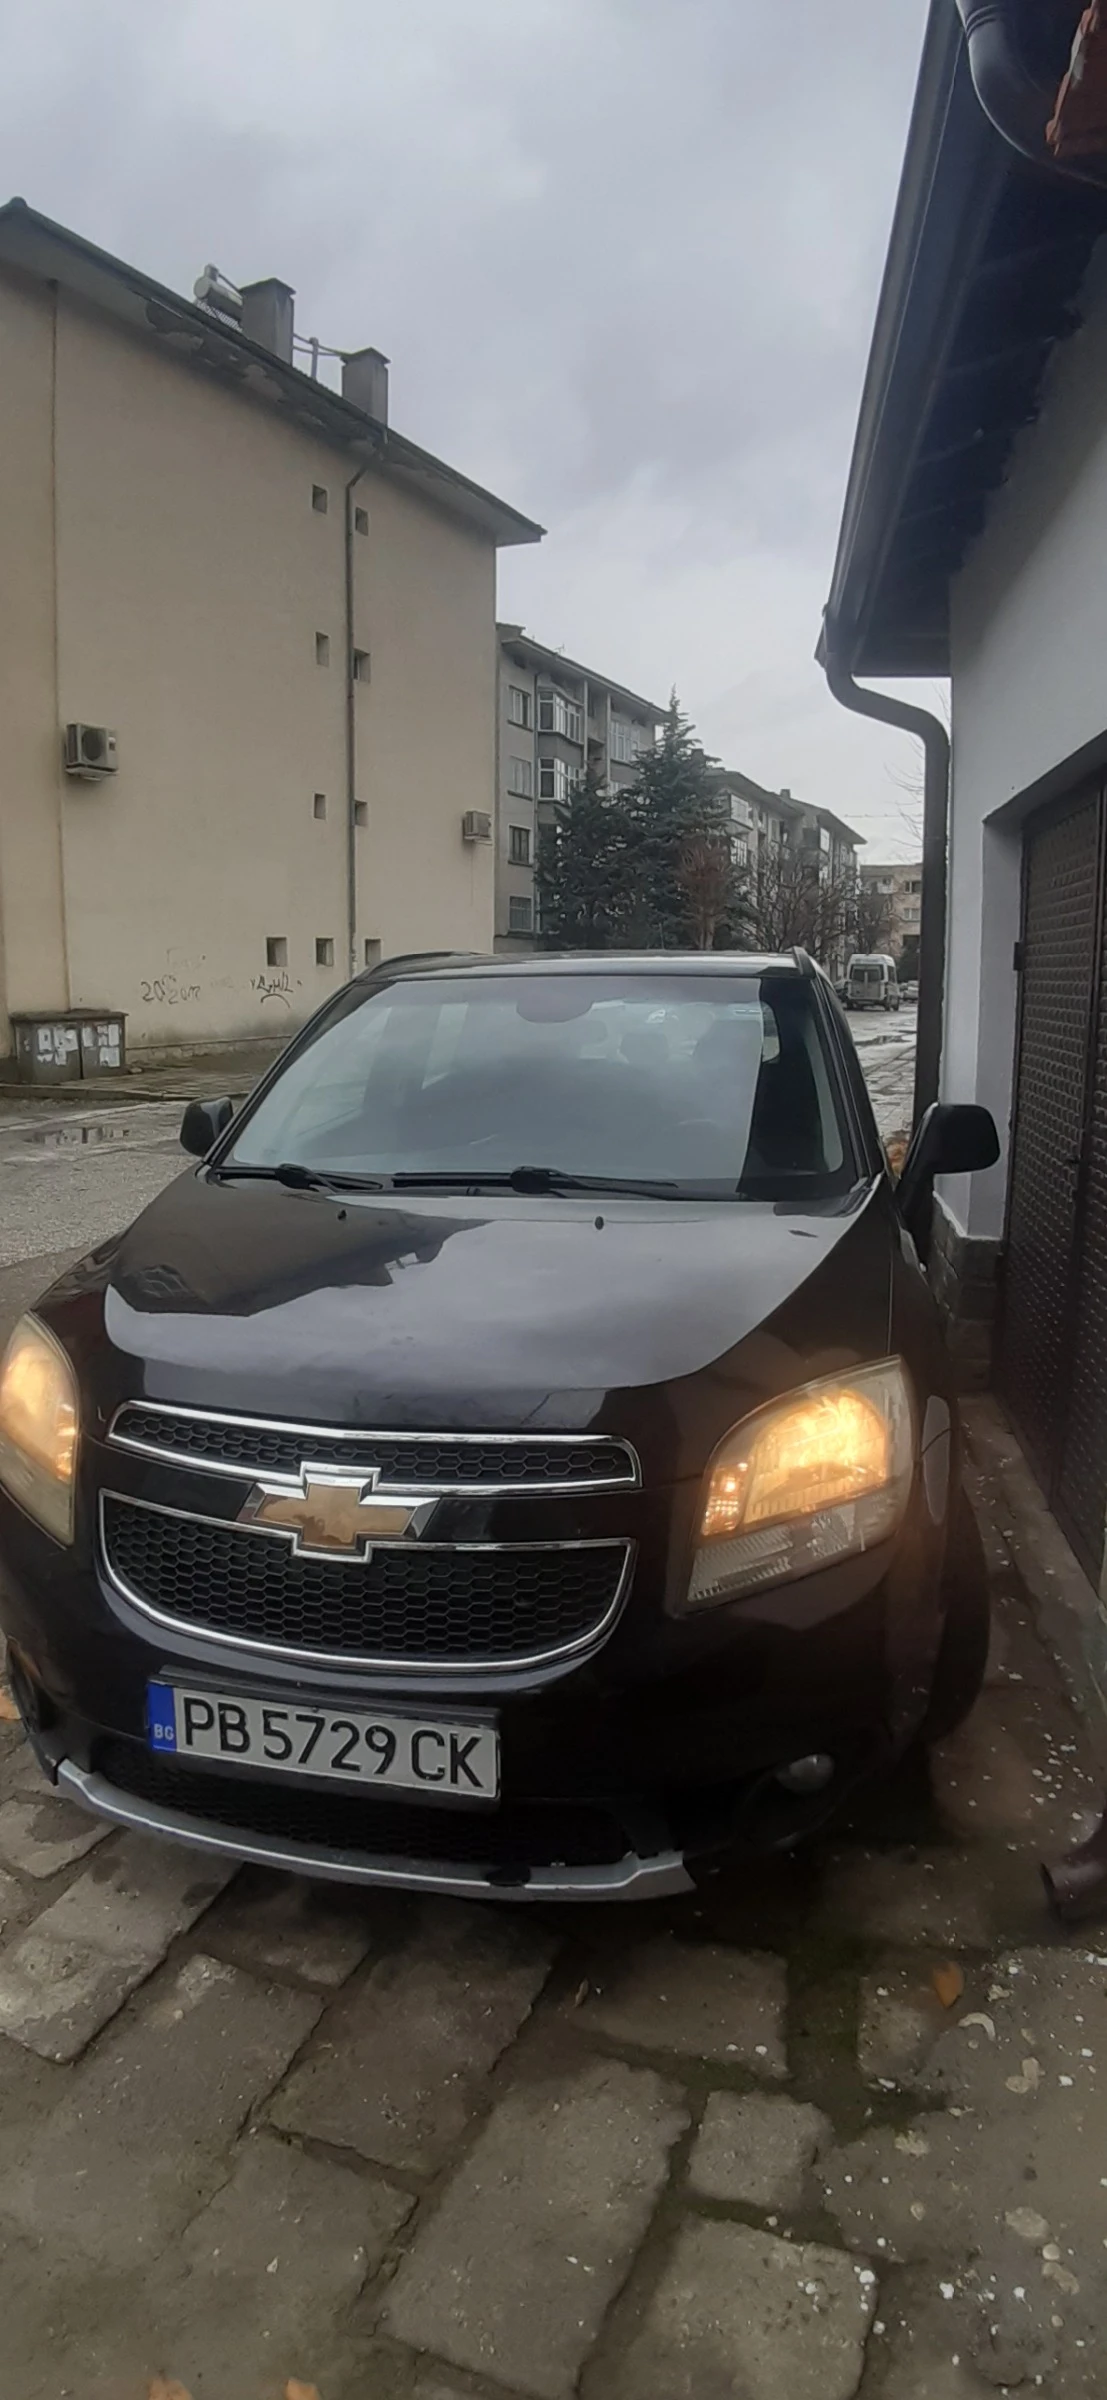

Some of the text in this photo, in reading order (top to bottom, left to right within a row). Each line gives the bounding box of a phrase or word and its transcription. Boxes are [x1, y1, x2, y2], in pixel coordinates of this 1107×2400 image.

[153, 1723, 175, 1742] BG
[183, 1696, 484, 1788] PB 5729 CK
